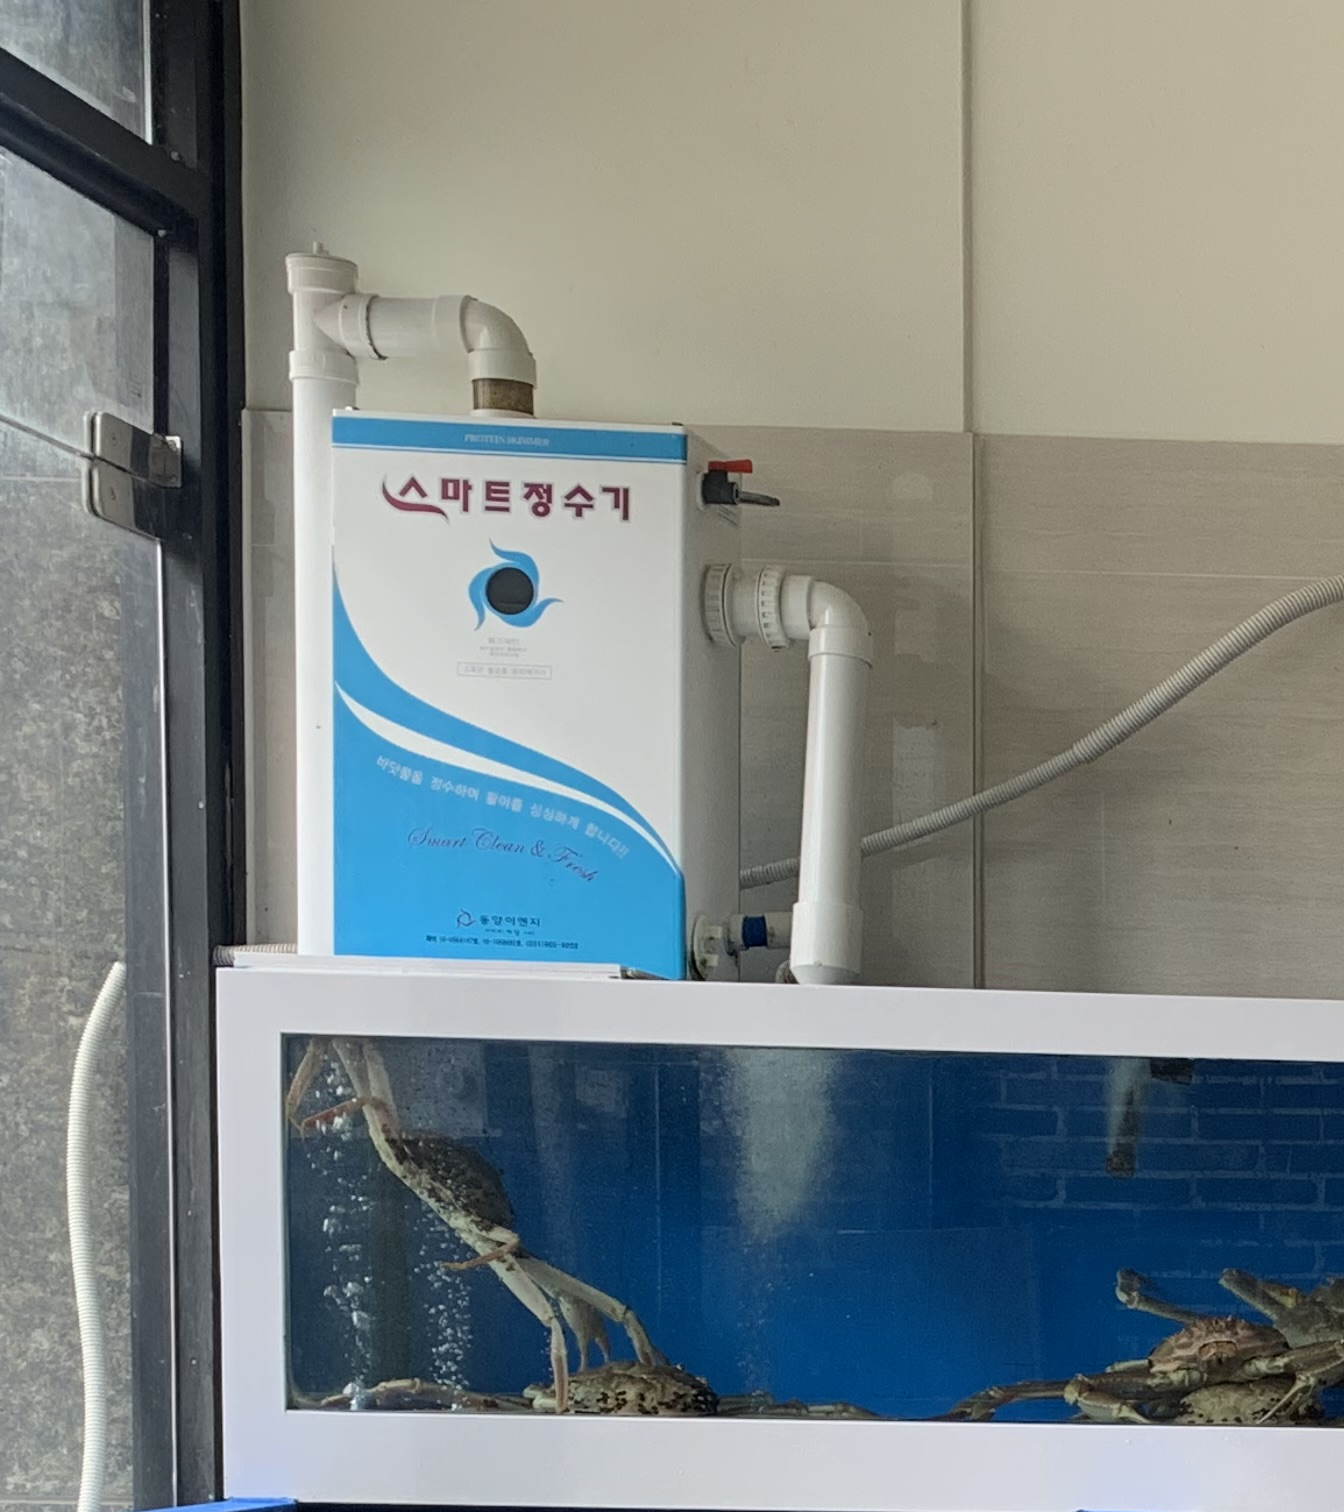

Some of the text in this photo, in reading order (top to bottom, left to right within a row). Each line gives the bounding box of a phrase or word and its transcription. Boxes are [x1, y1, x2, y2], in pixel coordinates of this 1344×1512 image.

[382, 474, 630, 522] 스마트정수기
[431, 776, 480, 801] 정수하여
[530, 803, 580, 830] 싱싱하게
[407, 828, 599, 882] Smart Clean & Fresh
